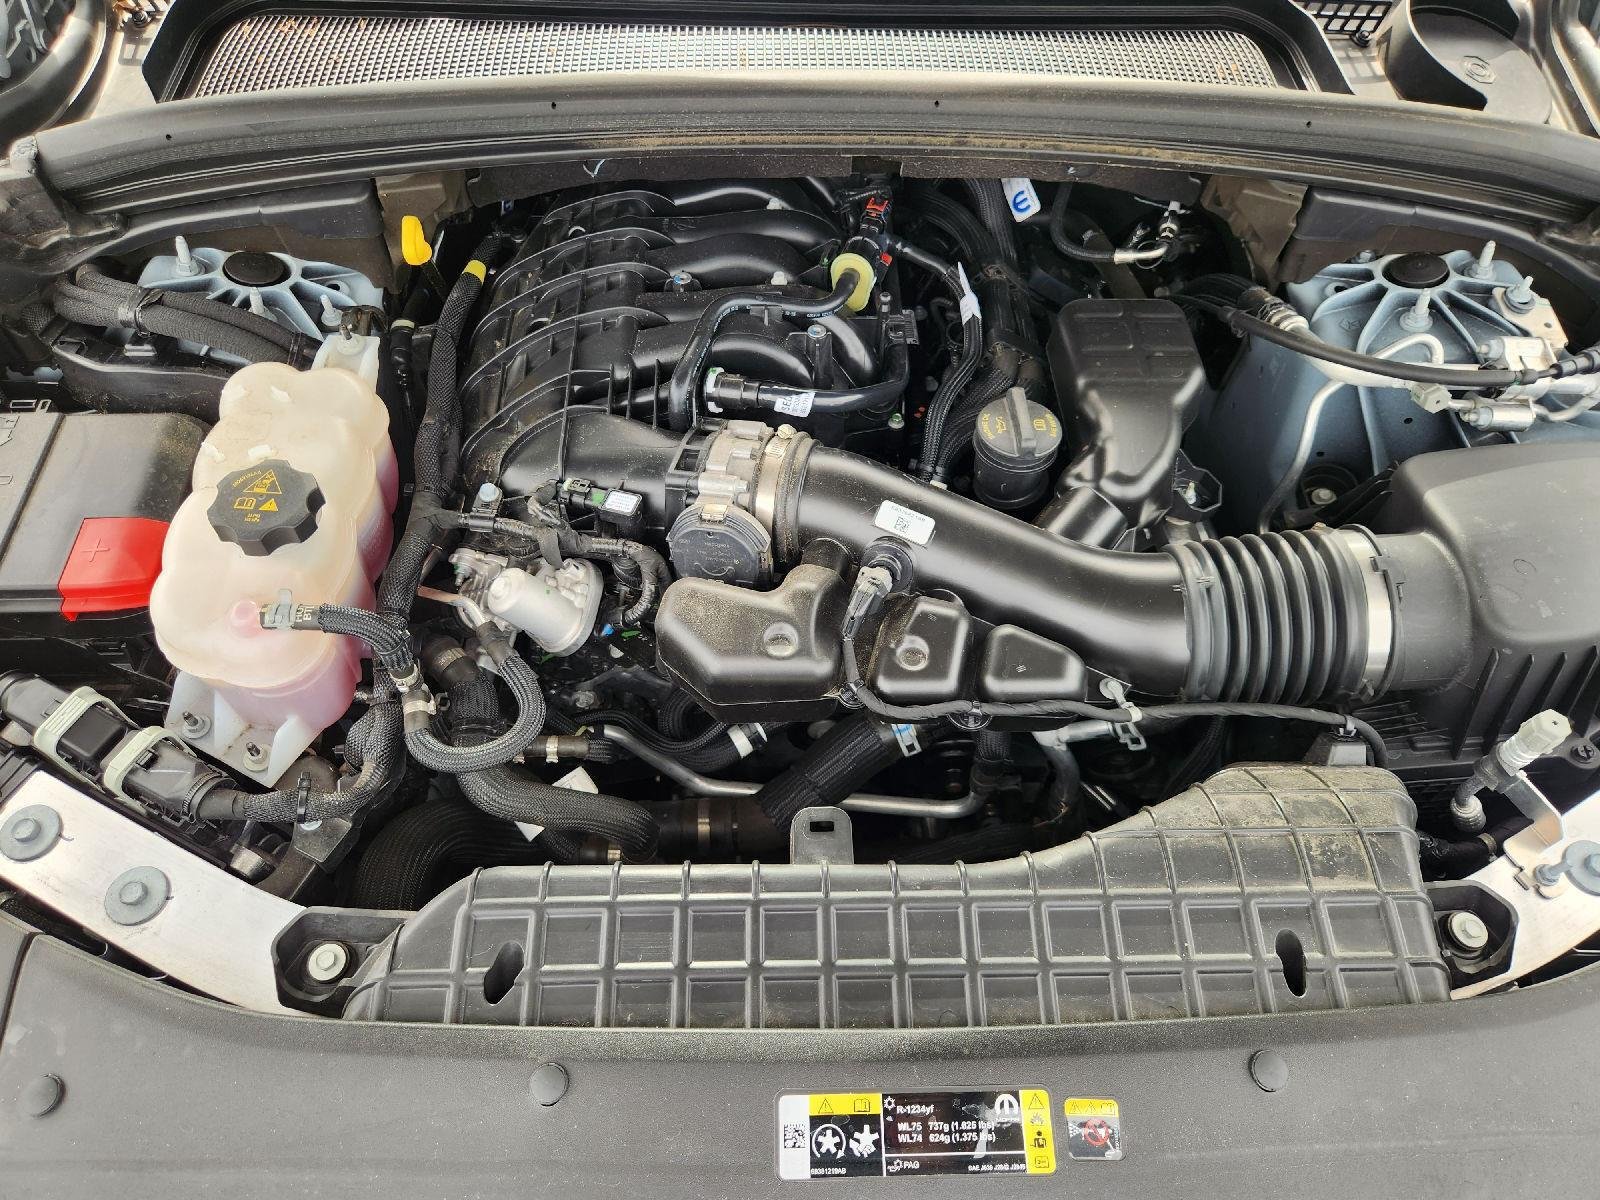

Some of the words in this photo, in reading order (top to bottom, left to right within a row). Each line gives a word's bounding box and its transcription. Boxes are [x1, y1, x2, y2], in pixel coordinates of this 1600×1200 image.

[896, 1104, 935, 1116] R-1234yf
[897, 1122, 922, 1132] WL75
[928, 1121, 949, 1132] 737g
[898, 1133, 923, 1143] WL74
[929, 1133, 950, 1144] 624g
[903, 1160, 920, 1170] PAG
